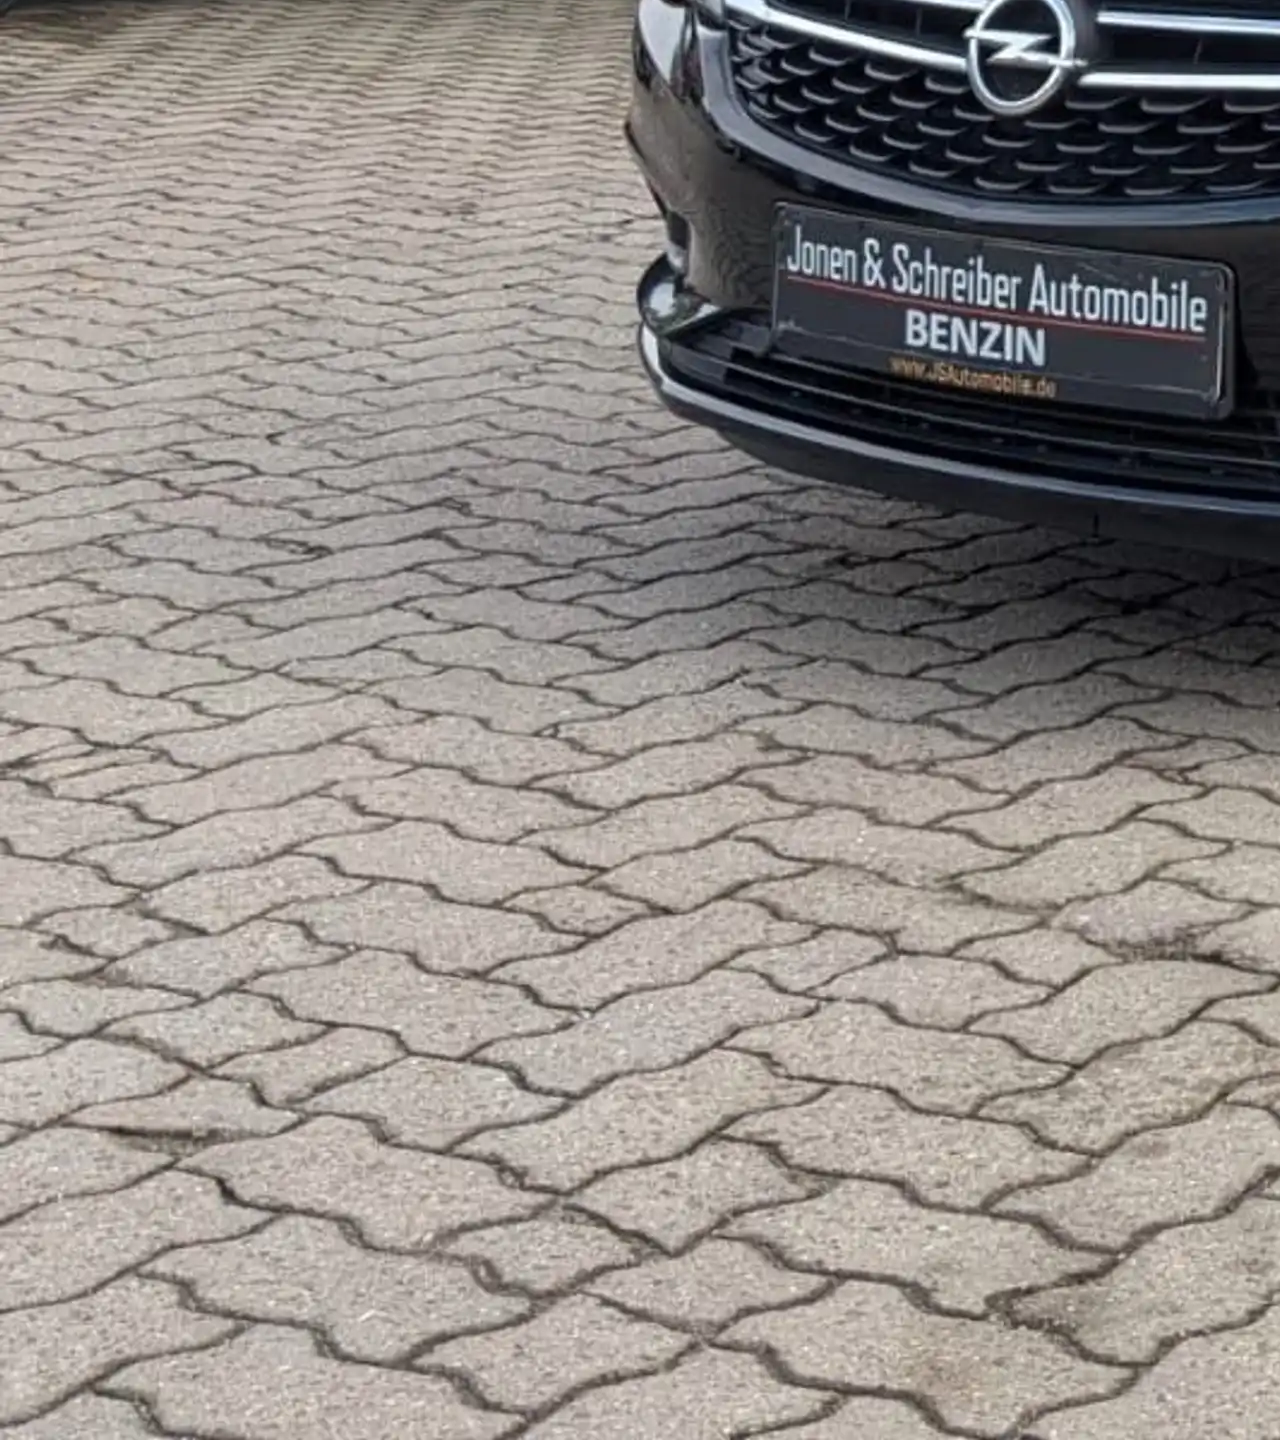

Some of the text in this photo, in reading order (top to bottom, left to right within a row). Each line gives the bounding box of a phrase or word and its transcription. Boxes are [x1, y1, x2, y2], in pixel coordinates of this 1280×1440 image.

[787, 225, 1208, 333] Jonen & Schreiber Automobile
[905, 308, 1046, 367] BENZIN
